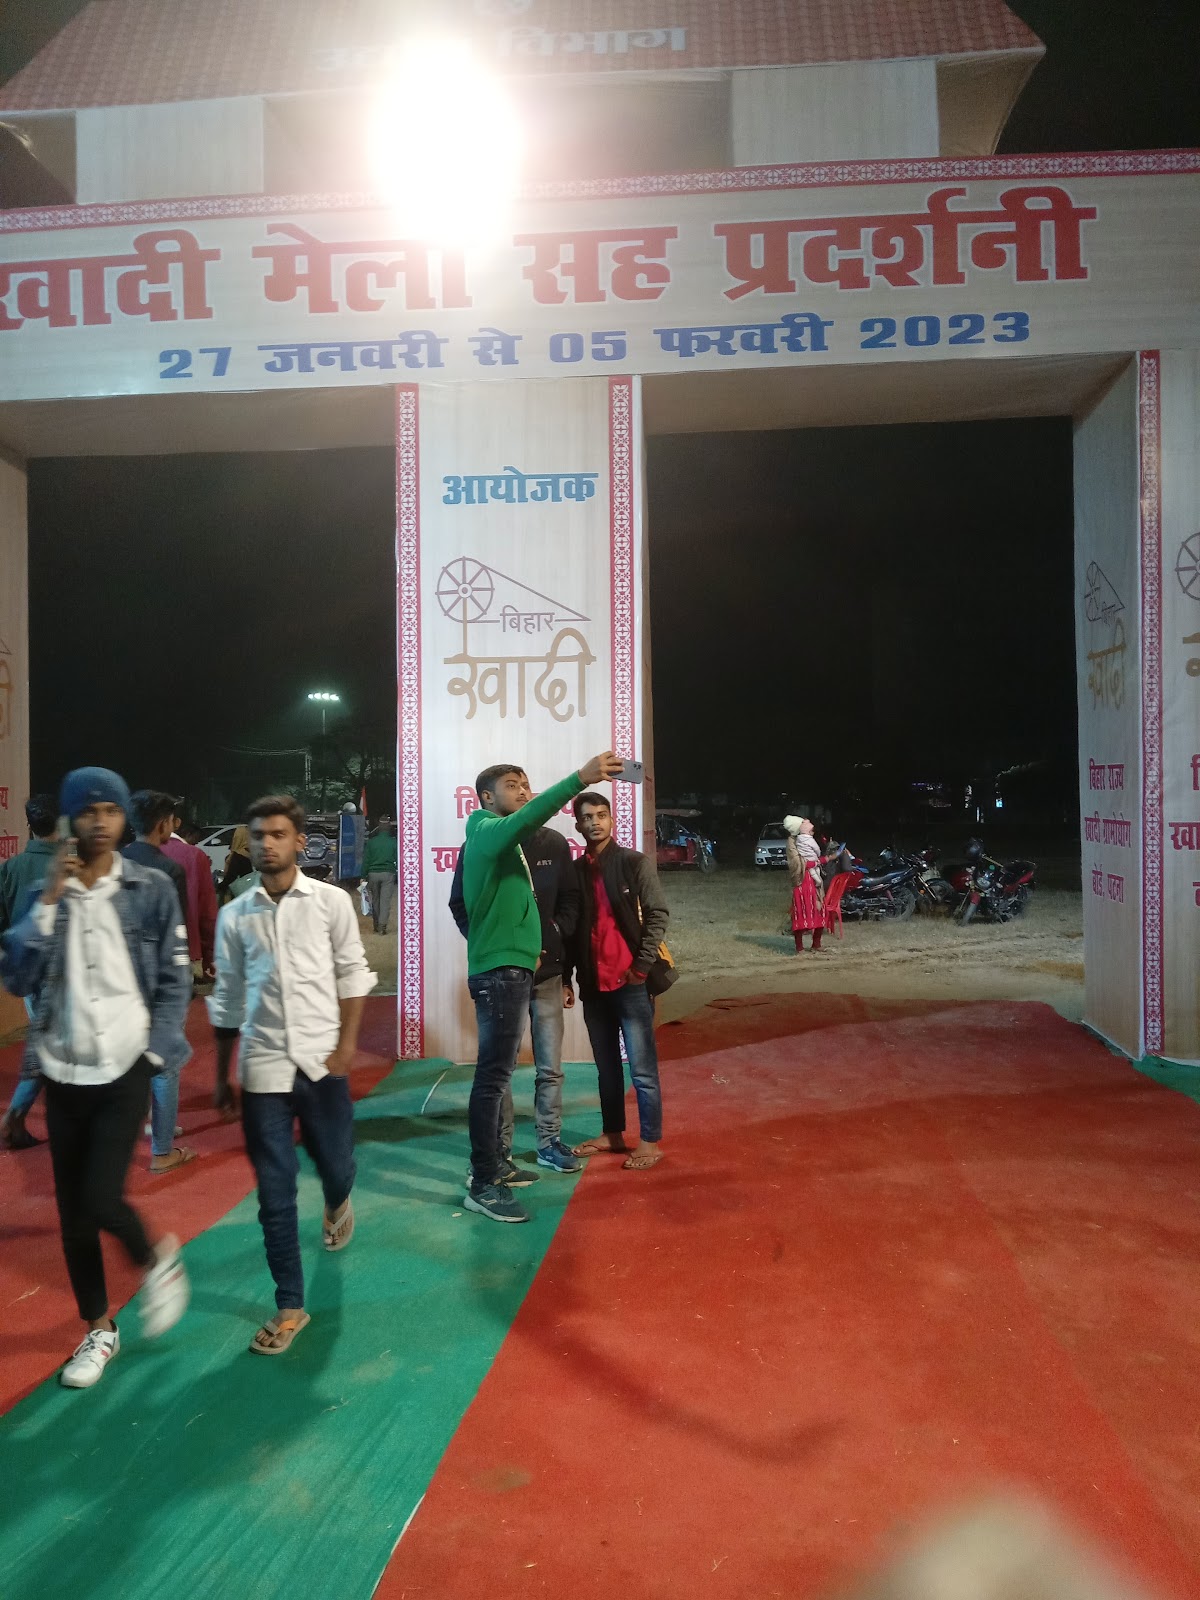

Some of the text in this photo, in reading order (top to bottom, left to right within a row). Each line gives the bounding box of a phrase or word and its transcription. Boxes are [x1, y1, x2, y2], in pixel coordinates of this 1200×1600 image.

[252, 223, 473, 314] मेला
[513, 226, 678, 305] सह
[714, 186, 1097, 301] प्रदर्शनी
[159, 311, 1030, 379] 27 जनवरी से 05 फरवरी 2023
[442, 465, 599, 505] आयोजक
[500, 605, 555, 634] बिहार
[443, 627, 597, 723] खादी
